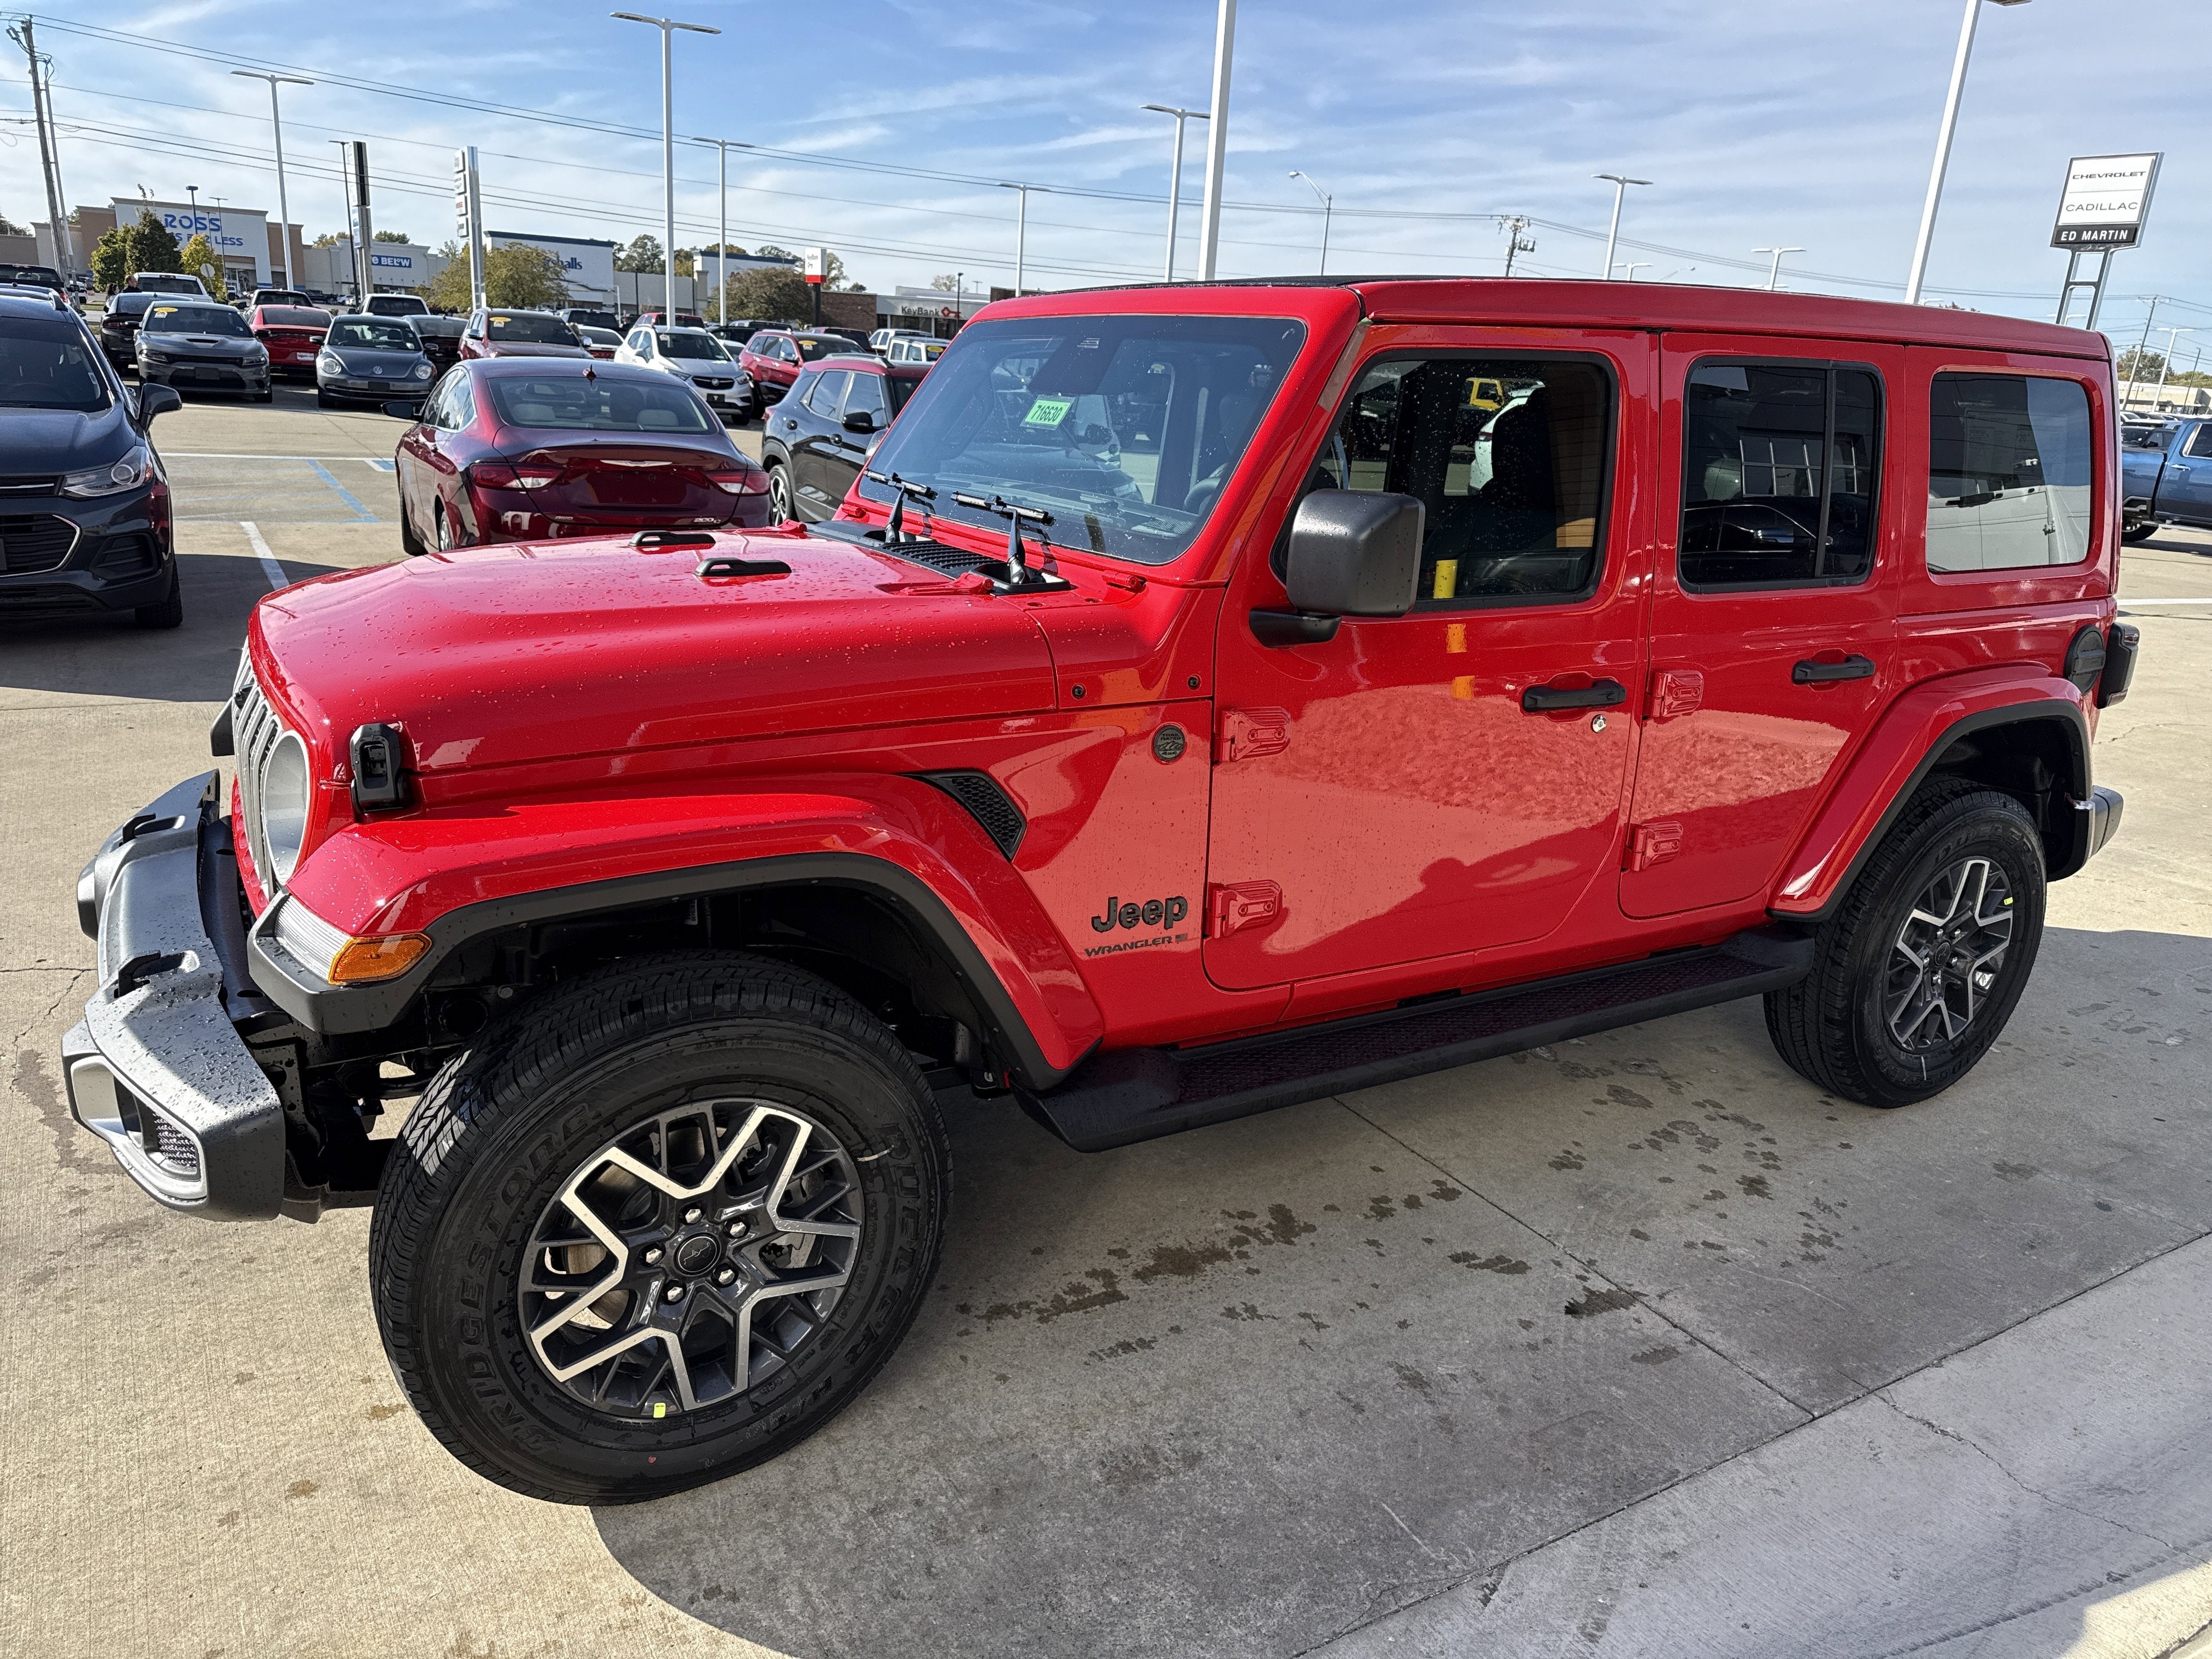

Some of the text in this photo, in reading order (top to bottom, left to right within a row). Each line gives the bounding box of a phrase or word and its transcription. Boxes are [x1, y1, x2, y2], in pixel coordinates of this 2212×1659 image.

[2072, 171, 2146, 180] CHEVROLET
[2066, 201, 2138, 212] CADILLAC
[164, 214, 221, 232] ROSS
[215, 236, 243, 246] LESS
[2061, 229, 2128, 241] ED MARTIN
[901, 306, 940, 317] KeyBank
[1031, 405, 1063, 422] 716630
[1091, 896, 1188, 933] Jeep
[1085, 936, 1172, 957] WRANGLER
